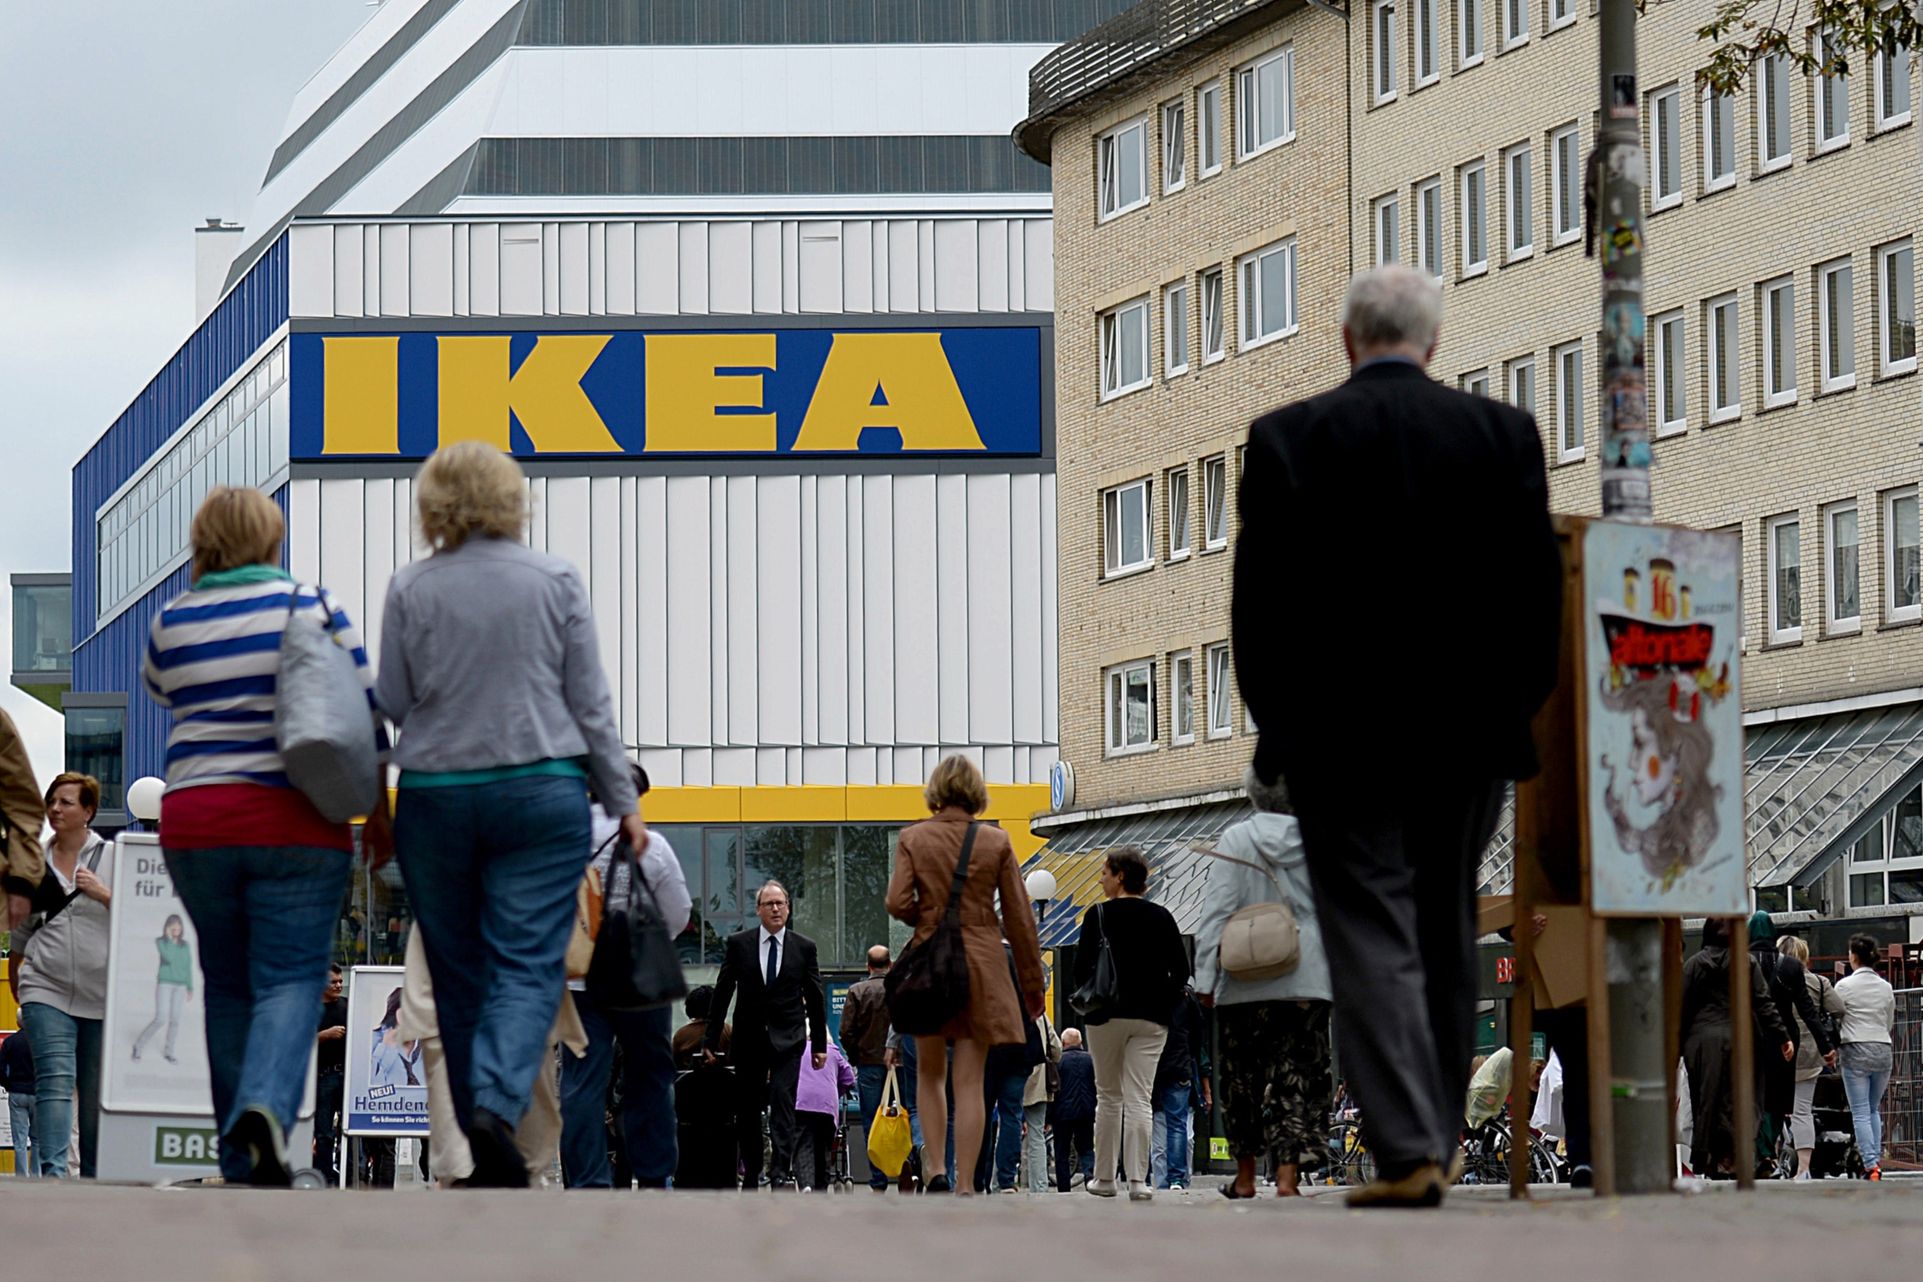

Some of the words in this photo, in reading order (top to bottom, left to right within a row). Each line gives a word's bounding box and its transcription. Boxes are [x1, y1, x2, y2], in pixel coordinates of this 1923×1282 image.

[321, 333, 988, 455] IKEA
[1651, 575, 1677, 620] 16
[136, 858, 168, 875] Die
[135, 880, 165, 897] für
[370, 1085, 394, 1099] NEU!
